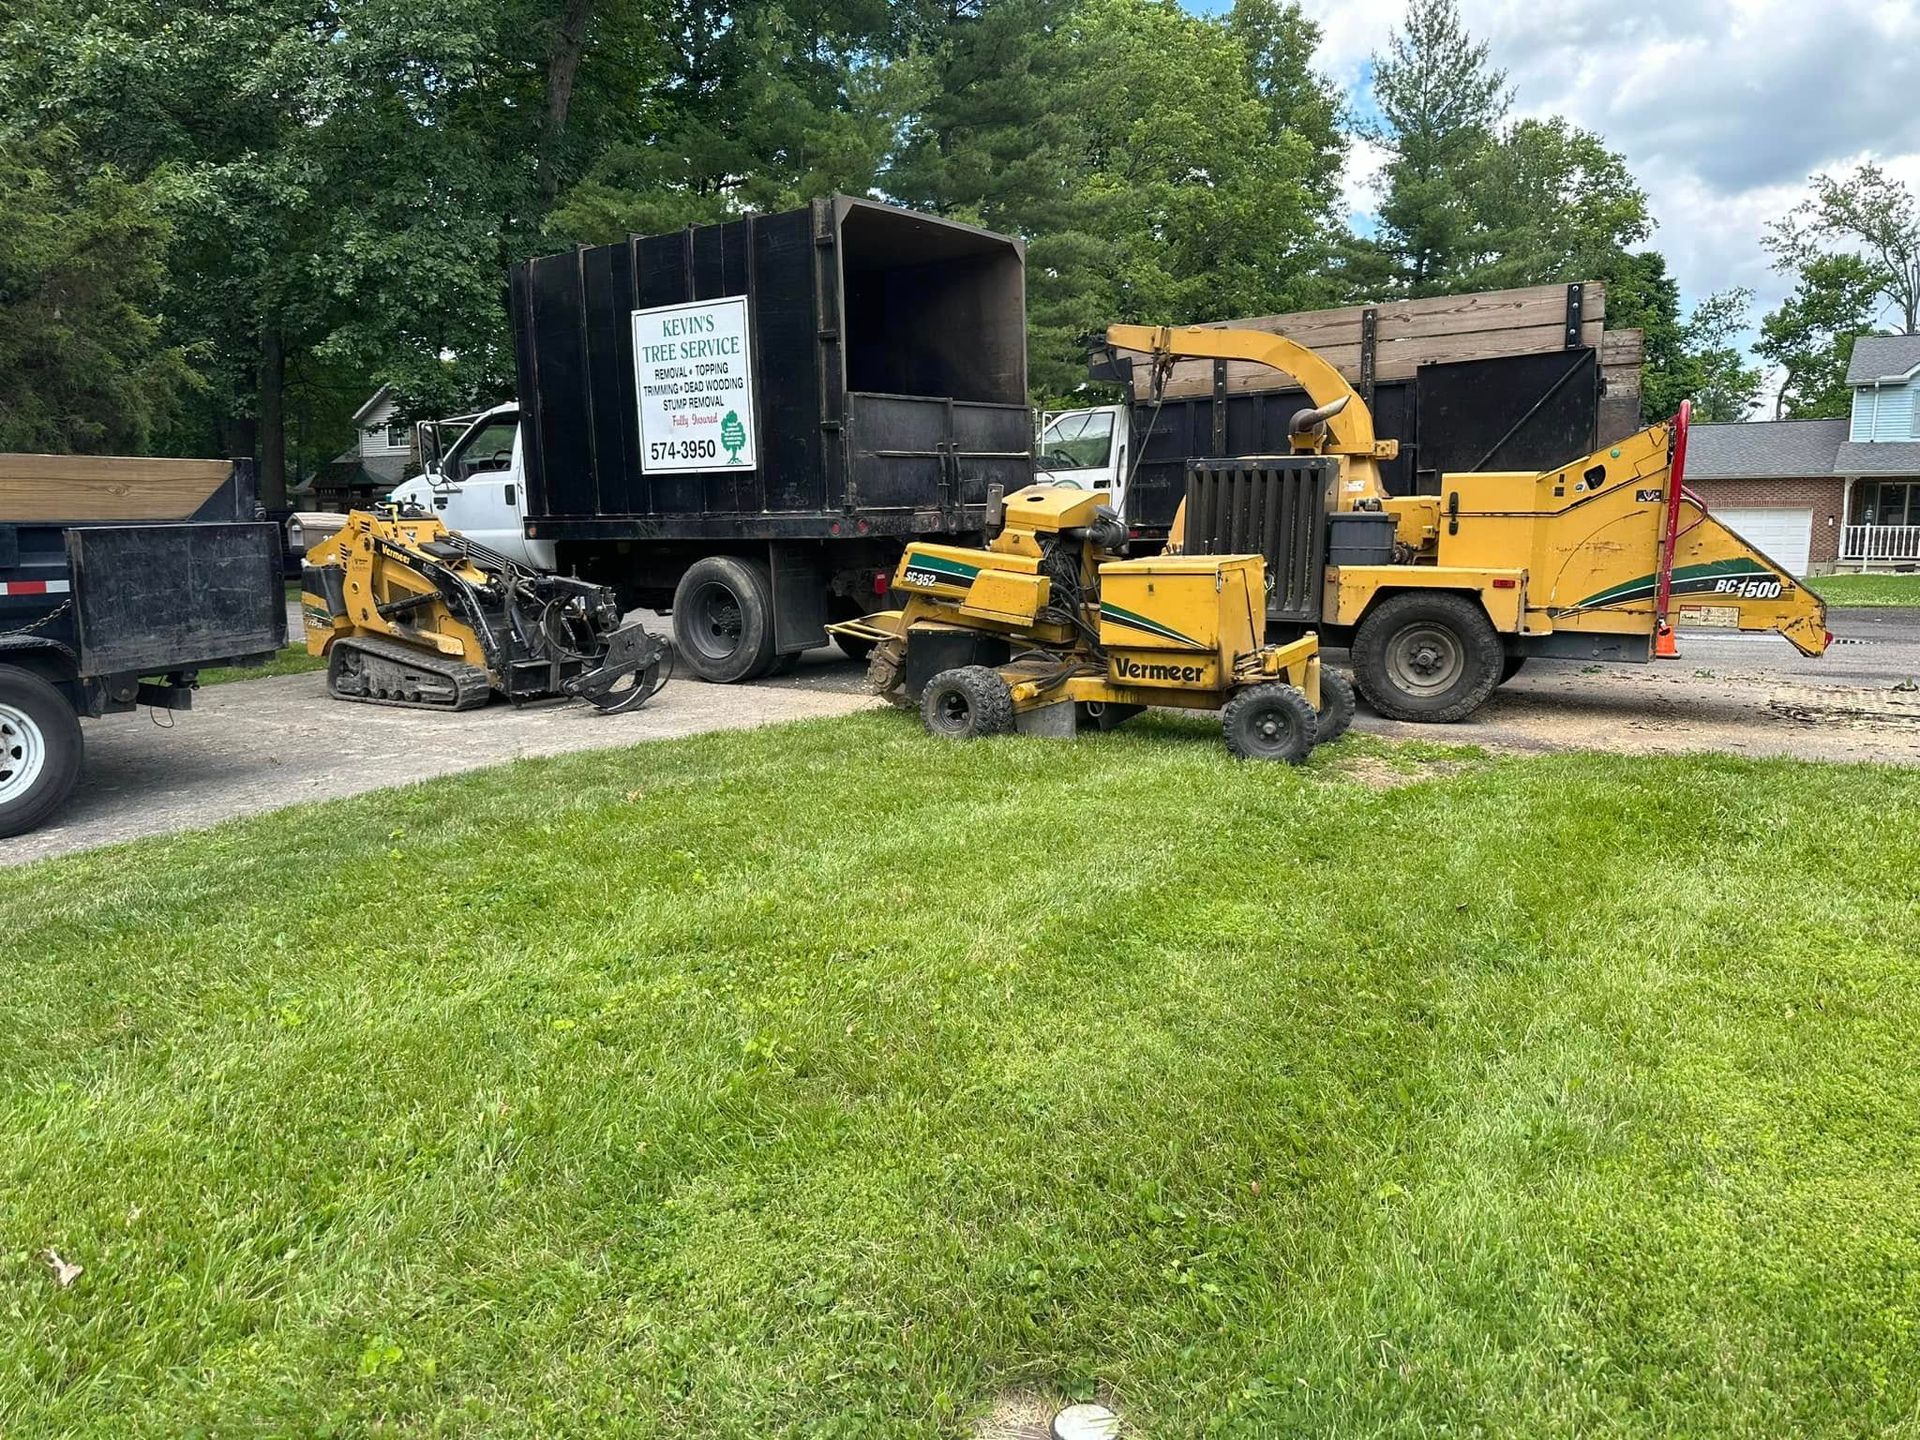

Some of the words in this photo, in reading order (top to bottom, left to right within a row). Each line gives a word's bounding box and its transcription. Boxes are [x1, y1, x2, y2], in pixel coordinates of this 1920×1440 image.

[662, 314, 715, 337] KEVIN'S
[642, 343, 677, 363] TREE
[680, 336, 740, 359] SERVICE
[654, 366, 688, 380] REMOVAL
[695, 362, 729, 376] TOPPING
[643, 383, 679, 397] TRIMMING
[684, 381, 704, 393] DEAD
[705, 377, 744, 391] WOODING
[663, 398, 687, 411] STUMP
[689, 395, 724, 409] REMOVAL
[672, 414, 689, 428] Fully
[651, 439, 716, 461] 574-3950
[381, 543, 410, 565] Vermeer
[905, 571, 937, 587] SC352
[1714, 579, 1782, 599] BC1500
[1115, 657, 1204, 682] Vermeer
